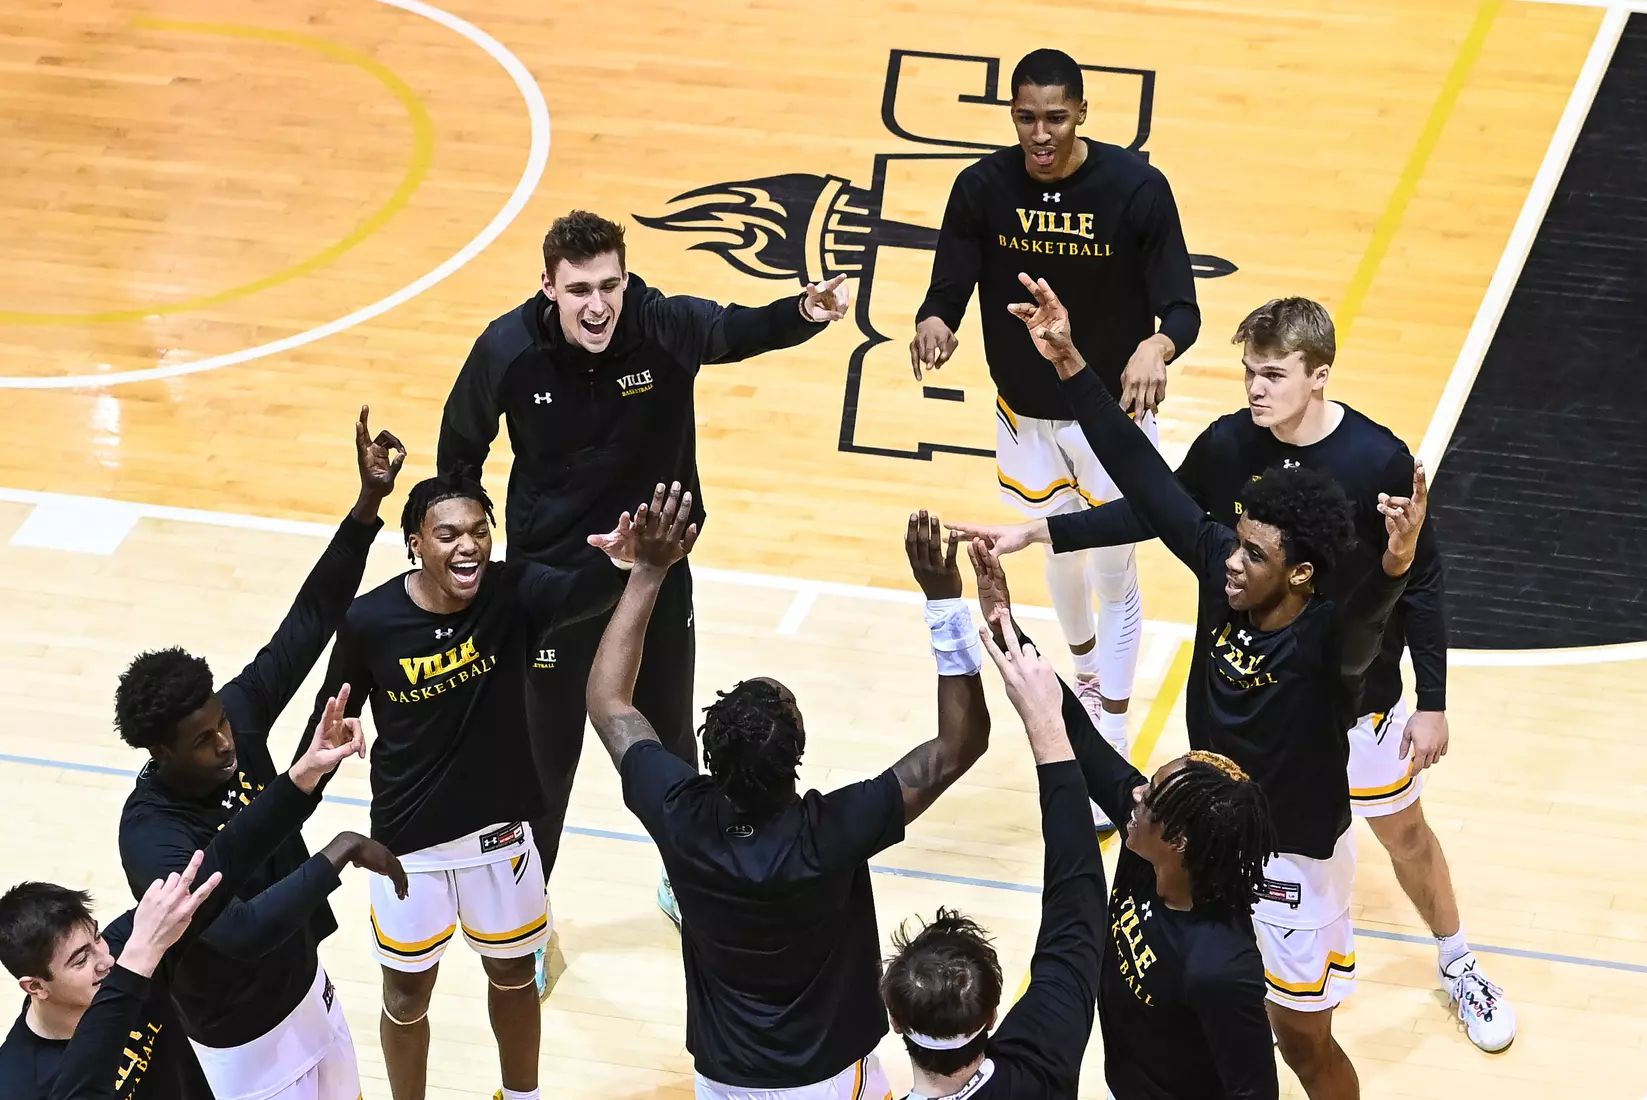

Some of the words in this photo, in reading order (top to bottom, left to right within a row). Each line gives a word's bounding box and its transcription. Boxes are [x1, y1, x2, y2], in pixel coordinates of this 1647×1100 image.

[1016, 208, 1095, 240] VILLE
[998, 234, 1114, 257] BASKETBALL
[616, 369, 654, 390] VILLE
[399, 635, 479, 685] VILLE
[387, 655, 497, 703] BASKETBALL
